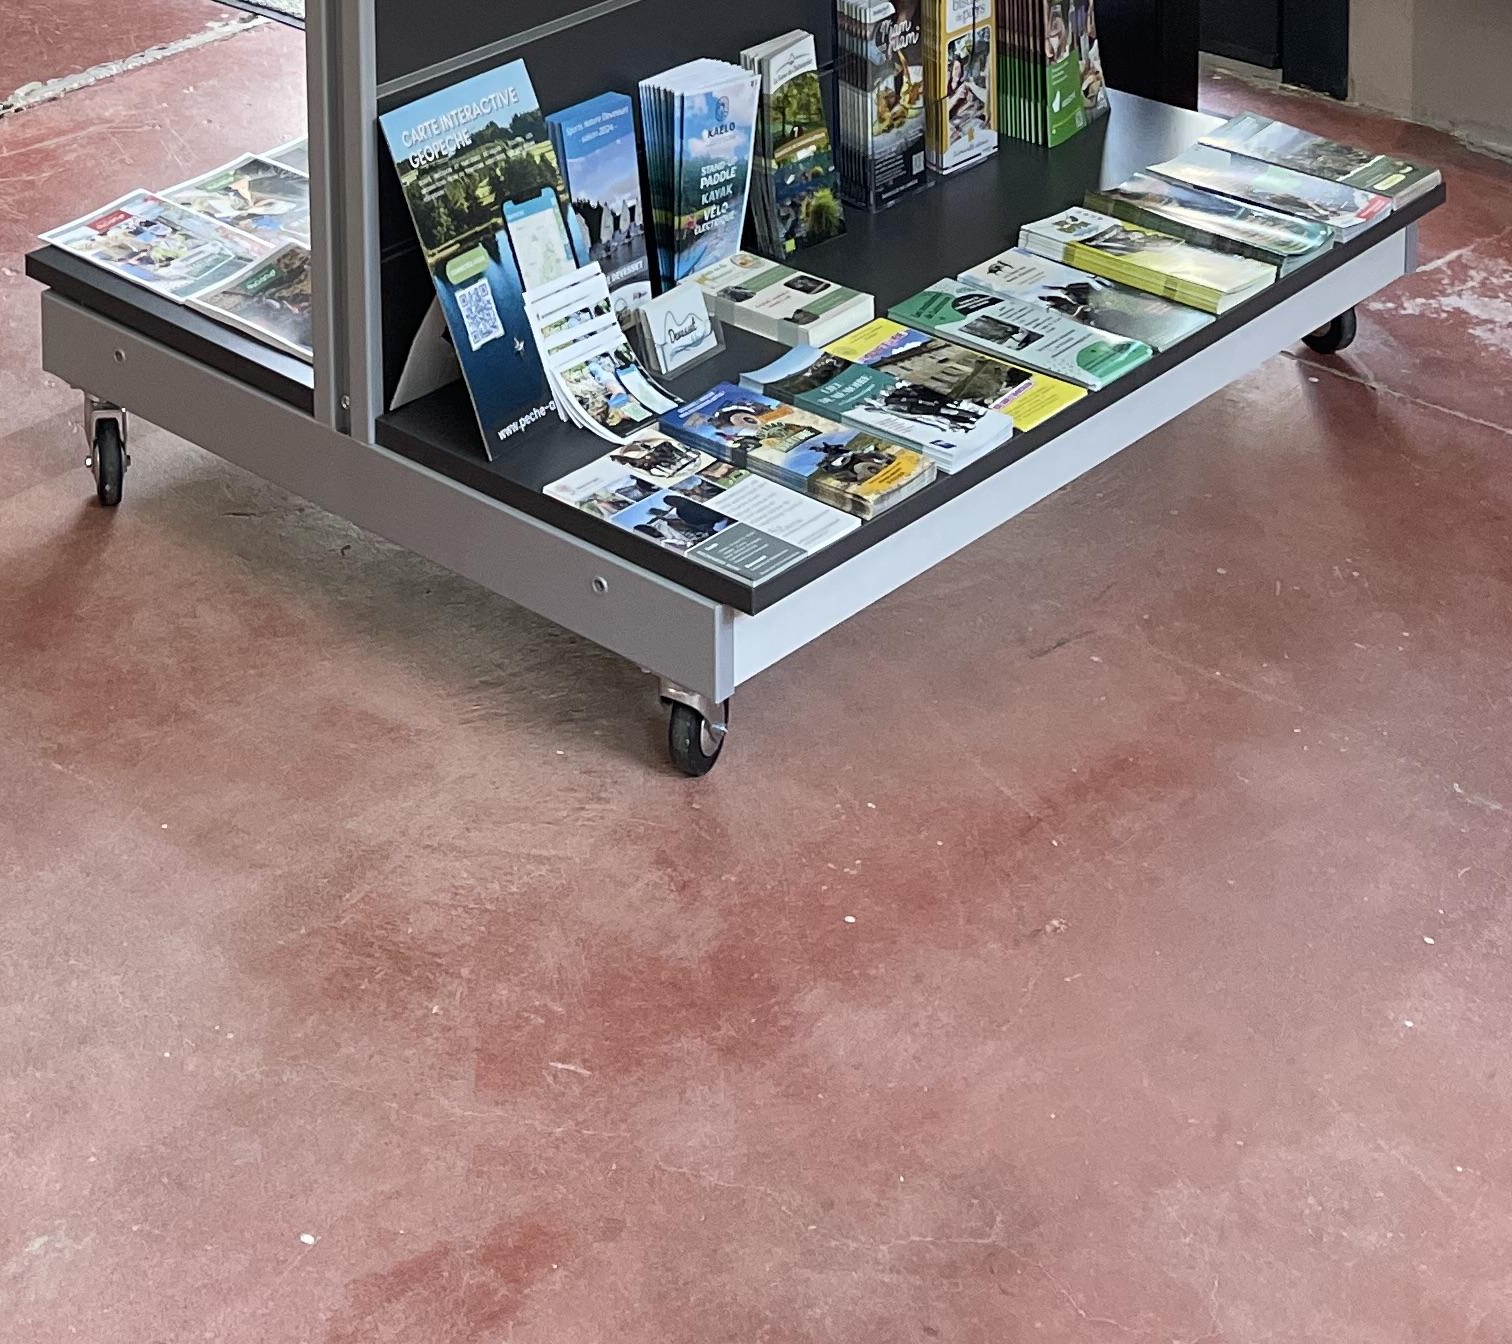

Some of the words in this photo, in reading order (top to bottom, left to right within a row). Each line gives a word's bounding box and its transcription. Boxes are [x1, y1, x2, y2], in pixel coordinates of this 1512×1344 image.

[401, 119, 440, 147] CARTE
[439, 86, 519, 132] INTERACTIVE
[409, 128, 473, 168] GEOPECHE
[700, 166, 737, 189] PADDLE
[701, 184, 733, 205] KAYAK
